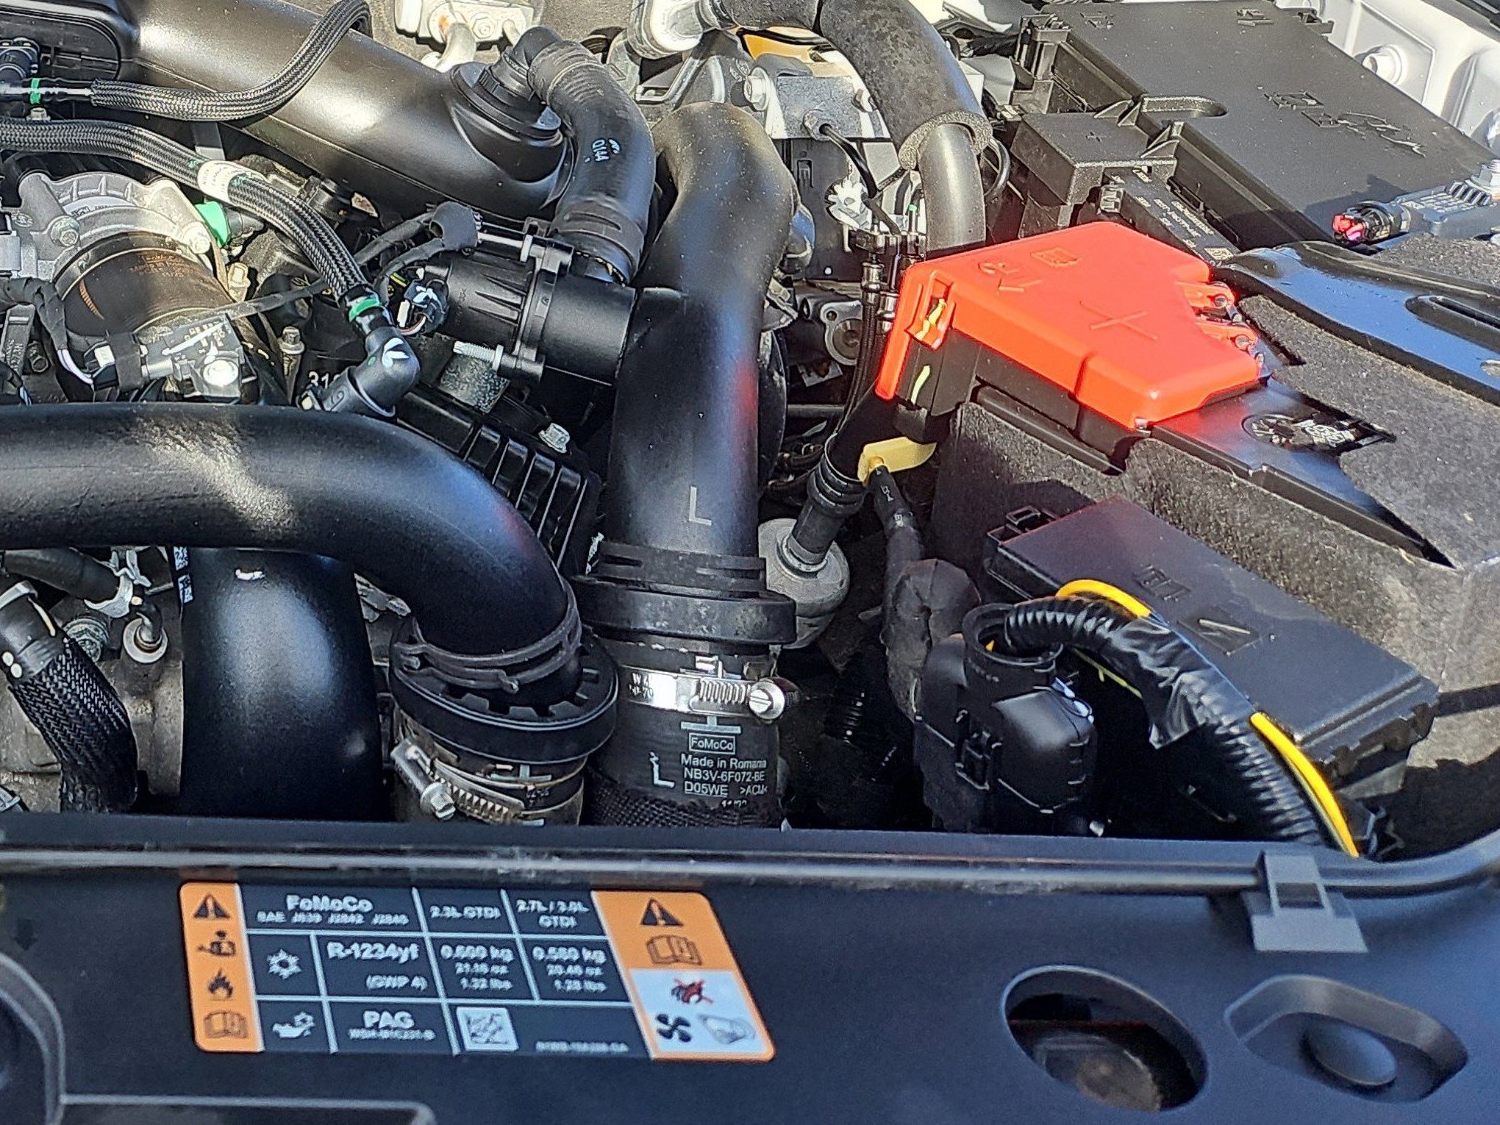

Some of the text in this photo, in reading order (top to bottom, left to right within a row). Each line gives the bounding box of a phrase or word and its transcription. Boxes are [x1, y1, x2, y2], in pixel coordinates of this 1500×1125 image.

[689, 486, 712, 525] L
[691, 737, 734, 751] FoMoCo
[681, 754, 714, 768] Made
[717, 758, 727, 766] in
[286, 895, 373, 912] FoMoCo
[327, 941, 420, 964] R-1234yf
[489, 945, 515, 963] kg
[581, 946, 607, 965] kg
[363, 1010, 415, 1030] PAG
